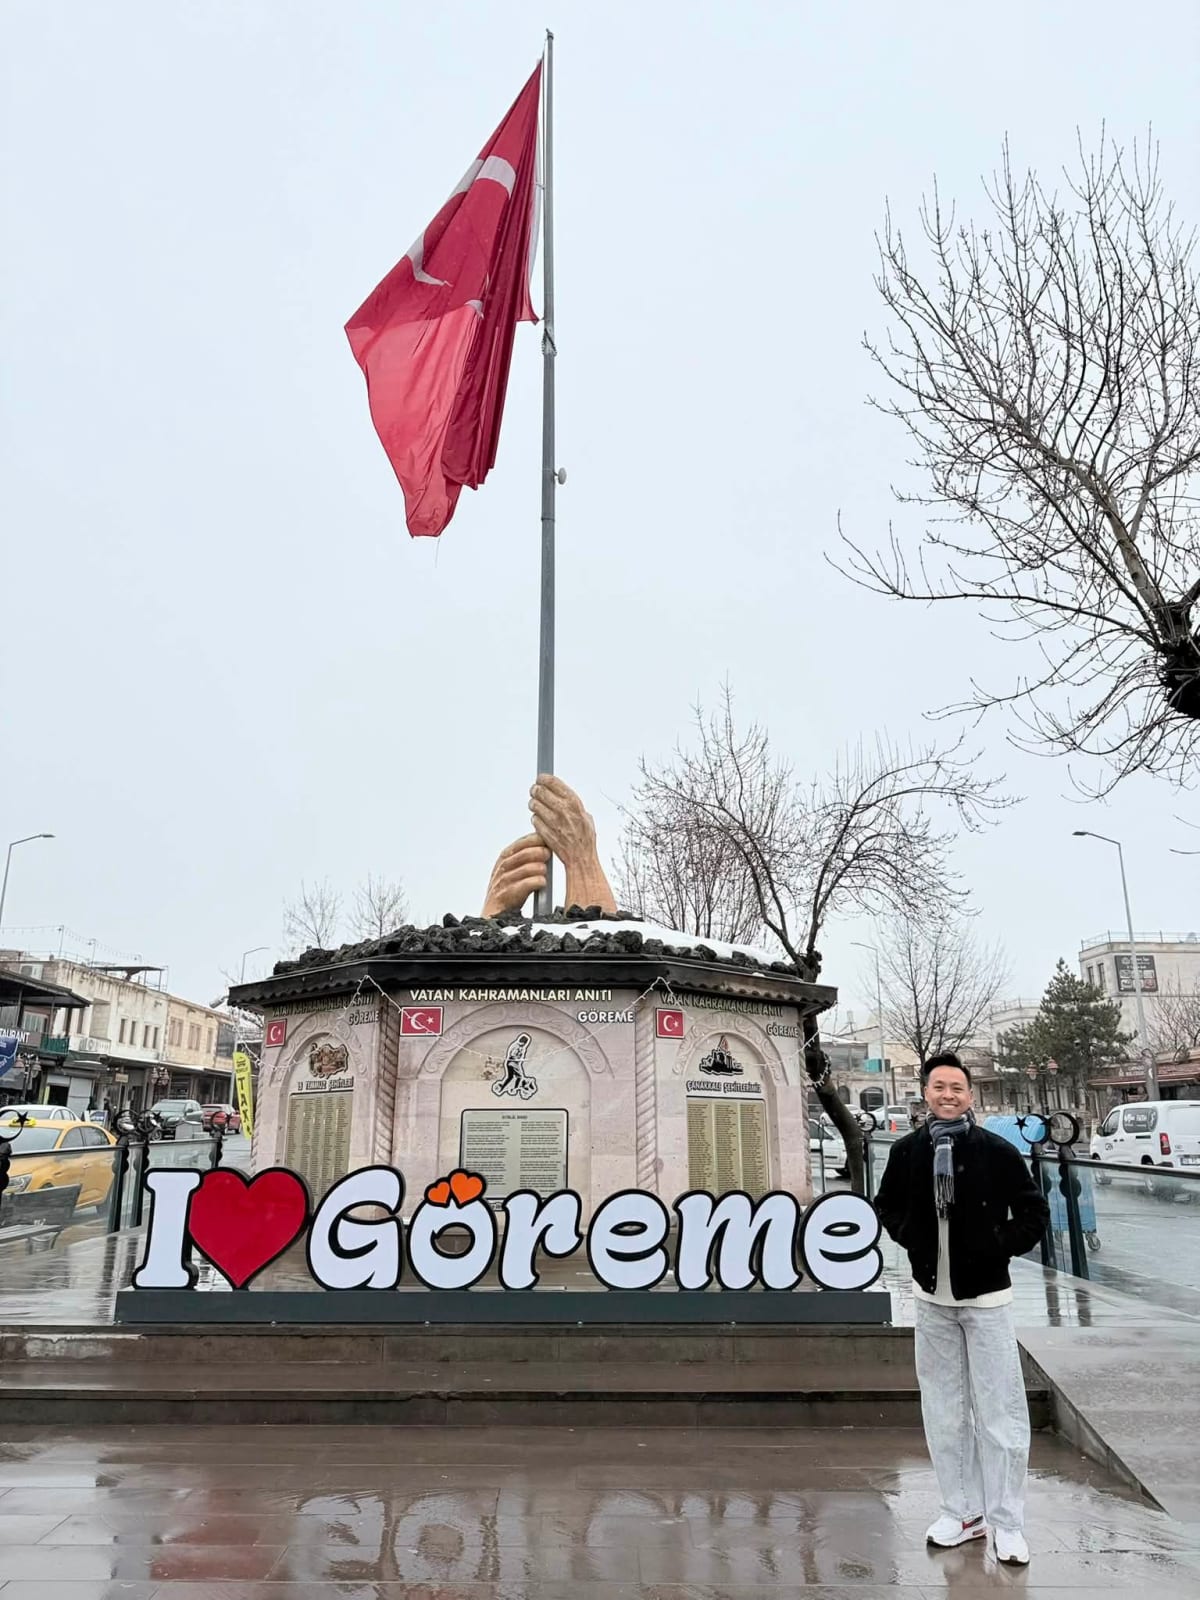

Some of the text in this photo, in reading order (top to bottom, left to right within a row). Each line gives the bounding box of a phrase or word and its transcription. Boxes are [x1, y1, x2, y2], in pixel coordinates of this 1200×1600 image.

[410, 989, 612, 1001] VATAN KAHRAMANLARI ANITI
[661, 991, 692, 1007] VATAN
[693, 994, 760, 1015] KAHRAMANLARI
[577, 1008, 635, 1023] GÖREME
[766, 1020, 799, 1037] GÖREME
[132, 1167, 201, 1291] I
